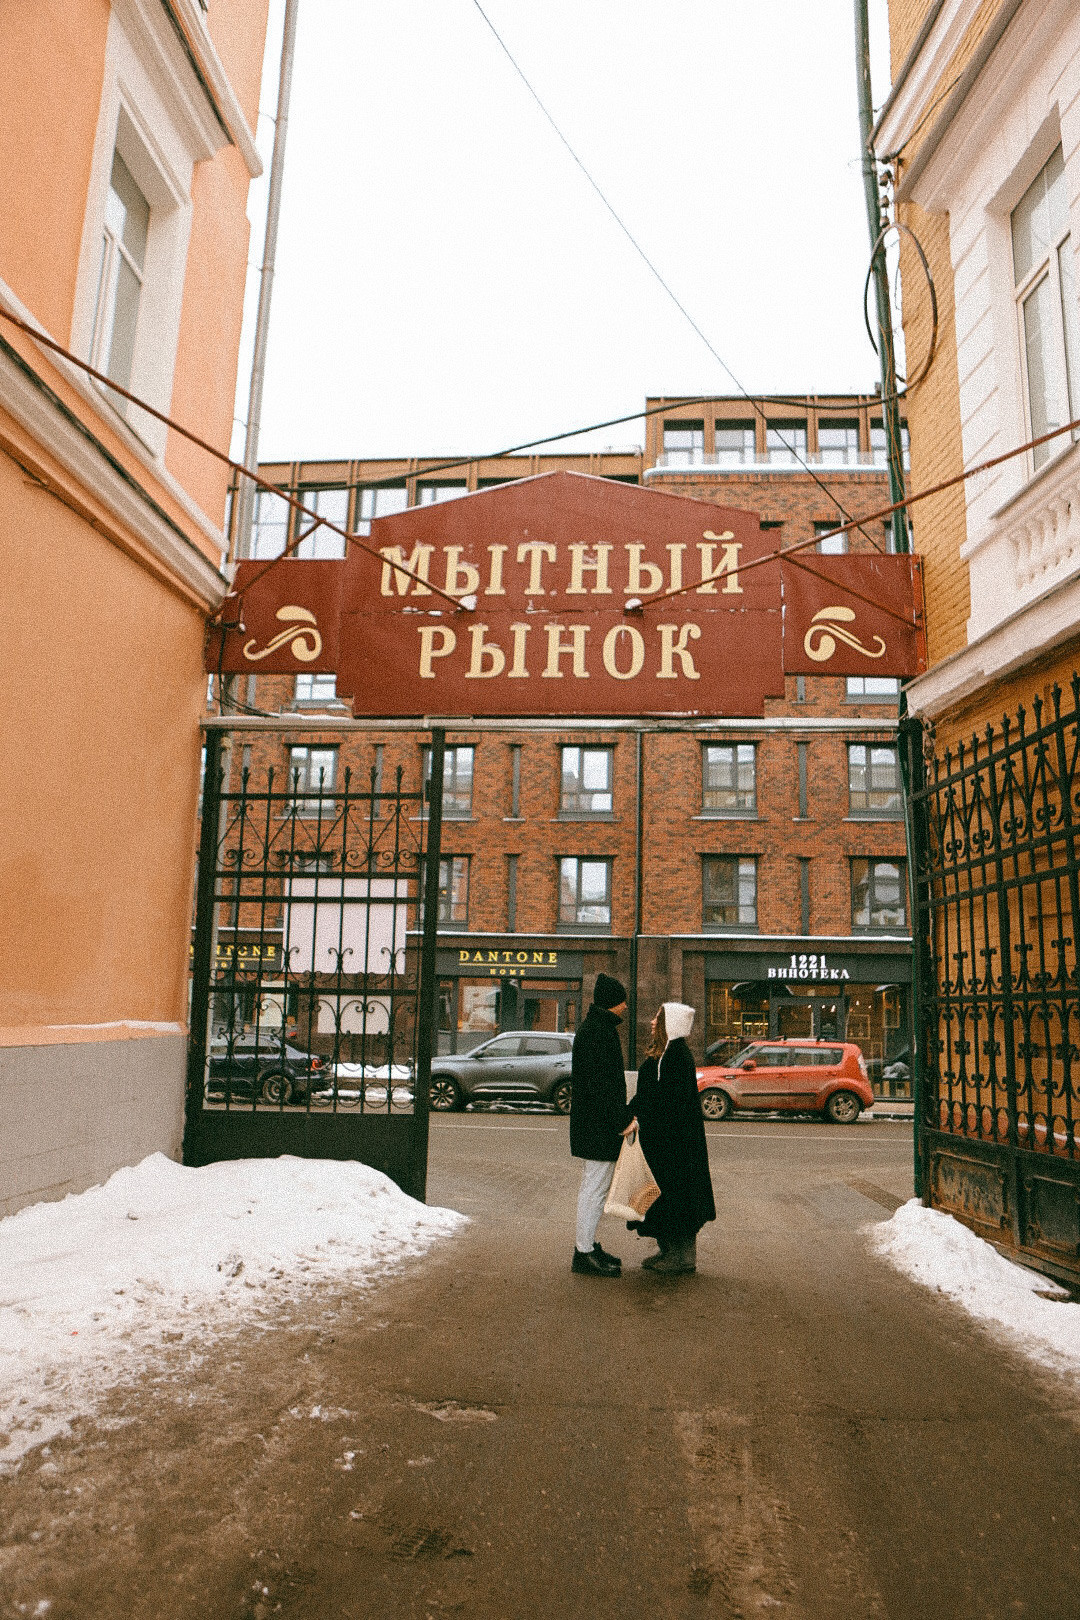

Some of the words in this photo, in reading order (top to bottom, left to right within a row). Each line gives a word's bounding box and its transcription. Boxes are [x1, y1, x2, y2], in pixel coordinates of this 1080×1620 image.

[378, 530, 743, 597] МЫТНЫЙ
[417, 623, 702, 680] РЫНОК
[459, 950, 558, 963] DANTONE
[789, 954, 827, 969] 1221
[489, 968, 526, 976] HOME
